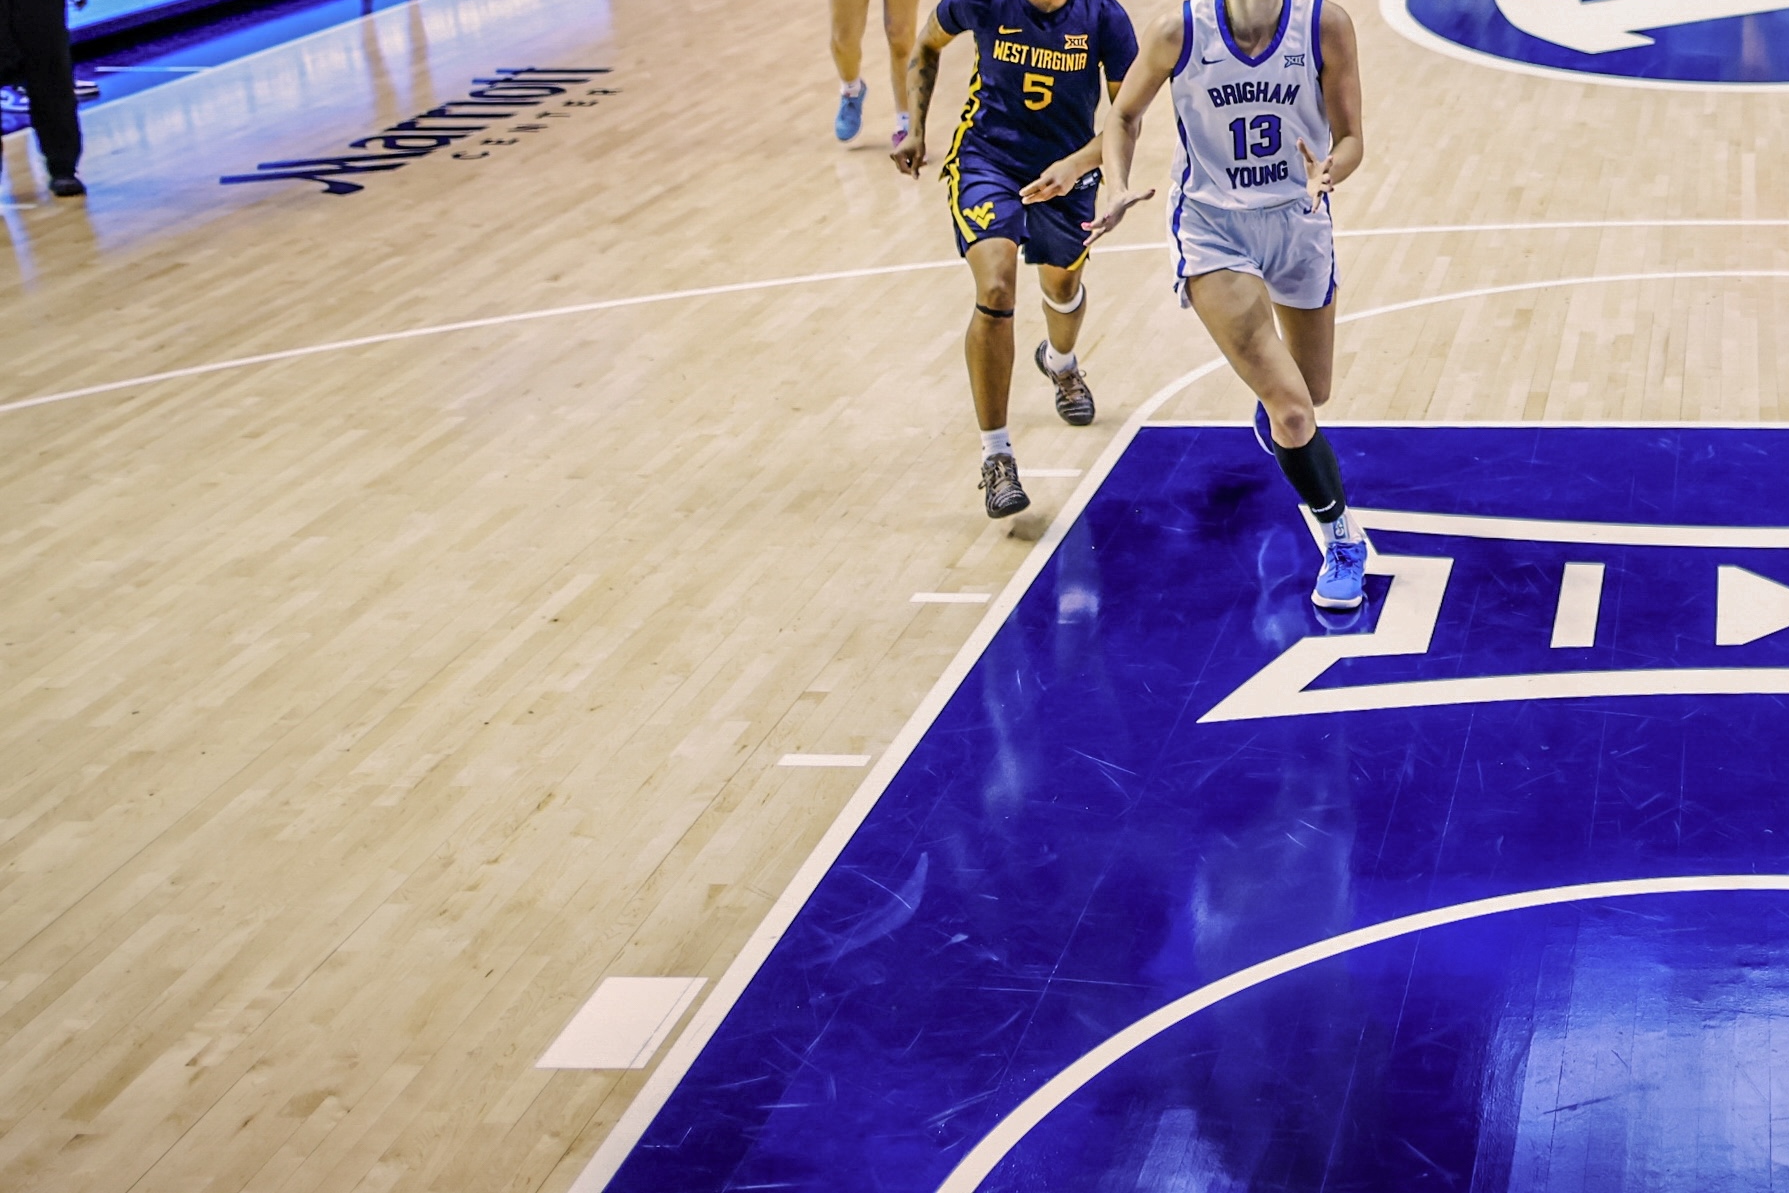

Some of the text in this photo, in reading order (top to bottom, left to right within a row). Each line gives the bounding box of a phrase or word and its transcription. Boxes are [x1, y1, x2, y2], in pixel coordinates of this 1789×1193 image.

[993, 40, 1088, 72] WEST VIRGINIA
[1023, 72, 1055, 111] 5
[1207, 81, 1301, 109] BRIGHAM
[220, 67, 614, 196] Marriott
[452, 89, 622, 160] CENTER
[1229, 114, 1282, 161] 13
[1226, 160, 1289, 190] YOUNG
